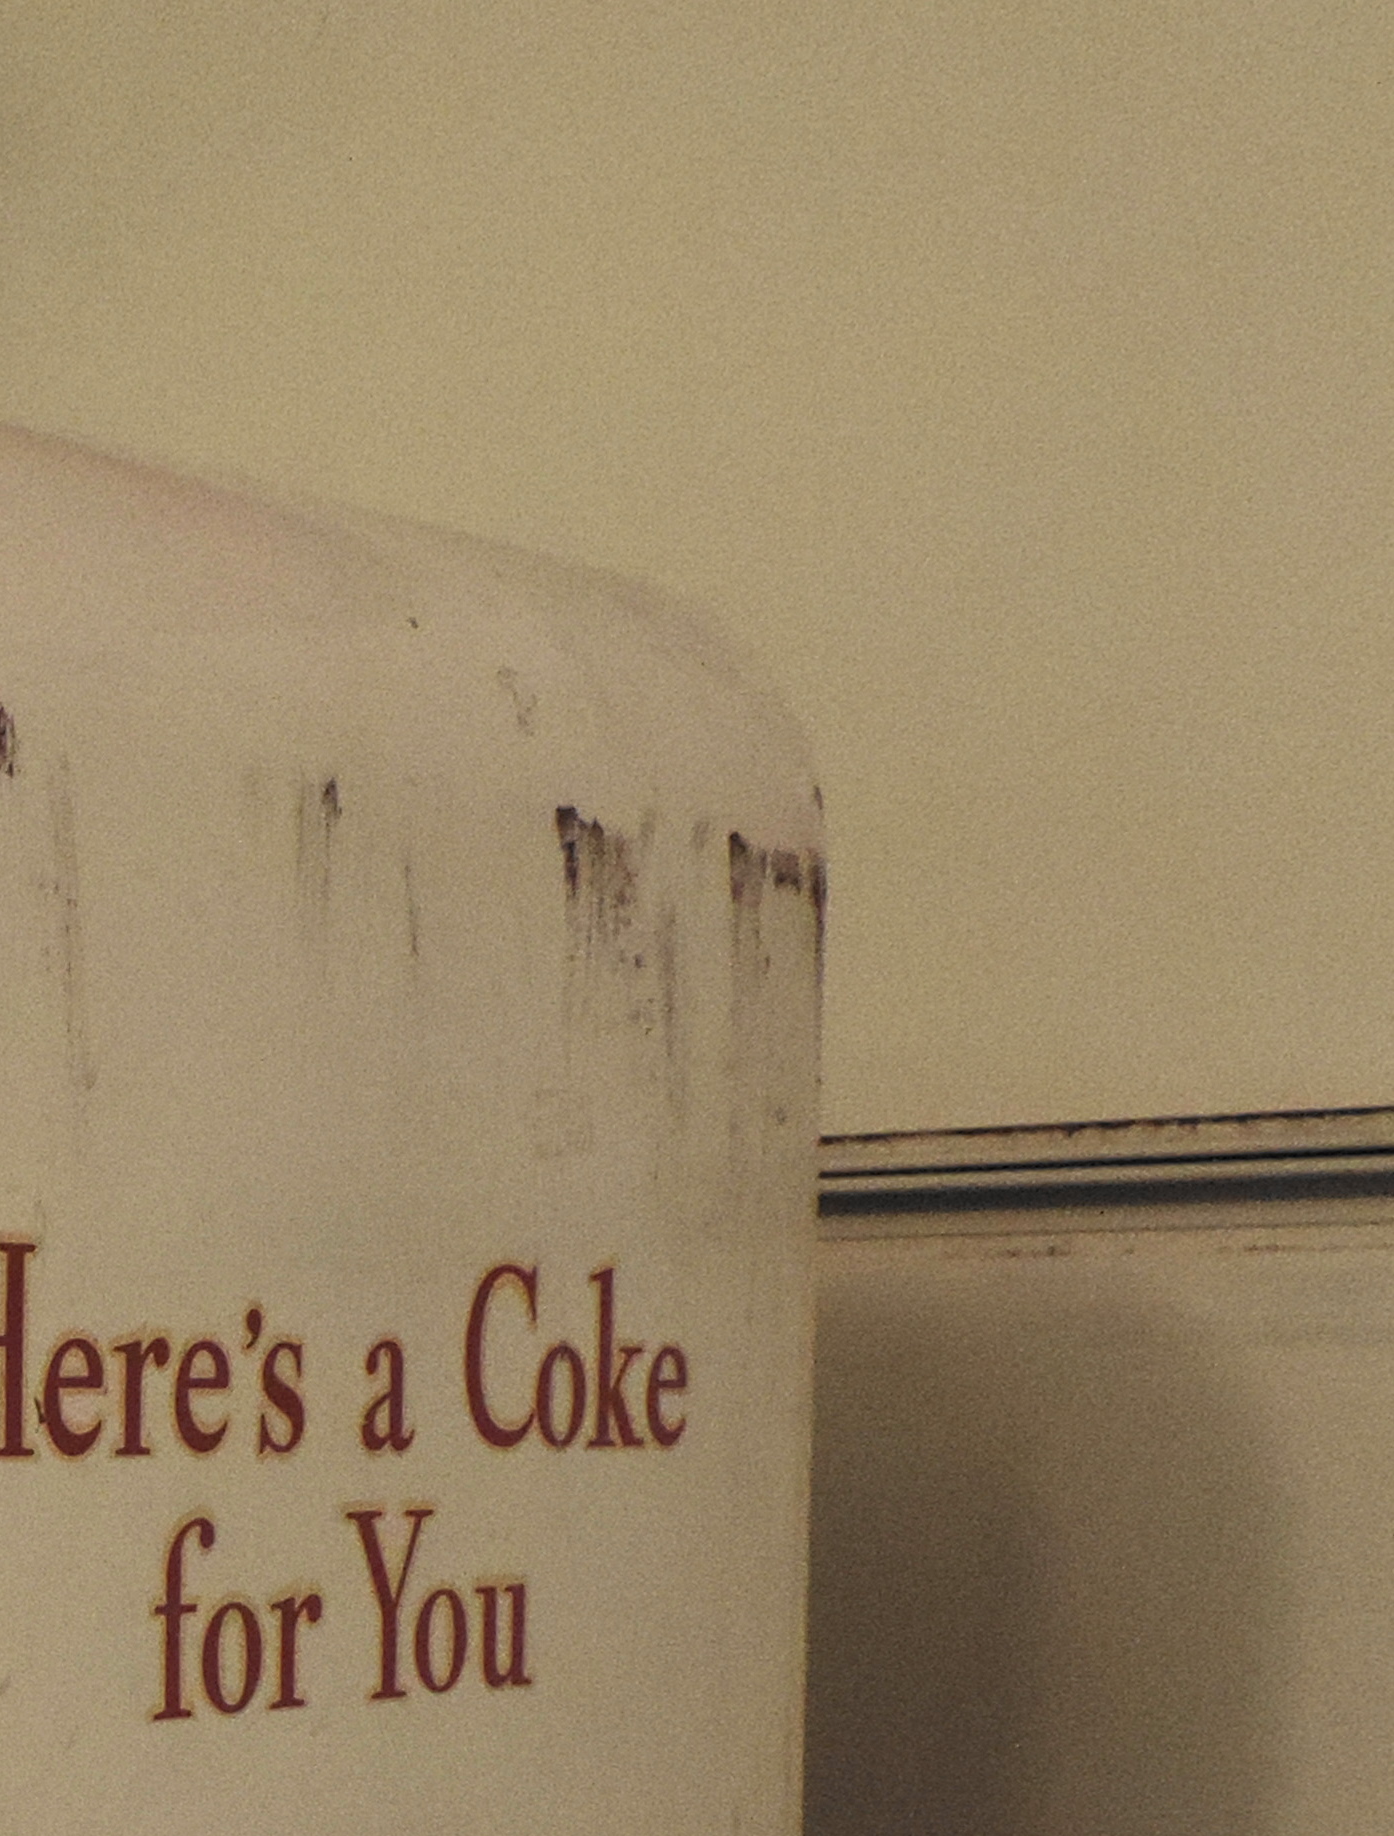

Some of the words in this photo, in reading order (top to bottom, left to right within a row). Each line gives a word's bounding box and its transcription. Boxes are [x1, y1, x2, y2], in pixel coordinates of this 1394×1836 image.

[362, 1336, 415, 1453] a
[464, 1262, 688, 1450] Coke
[153, 1516, 322, 1720] for
[345, 1508, 532, 1701] You
